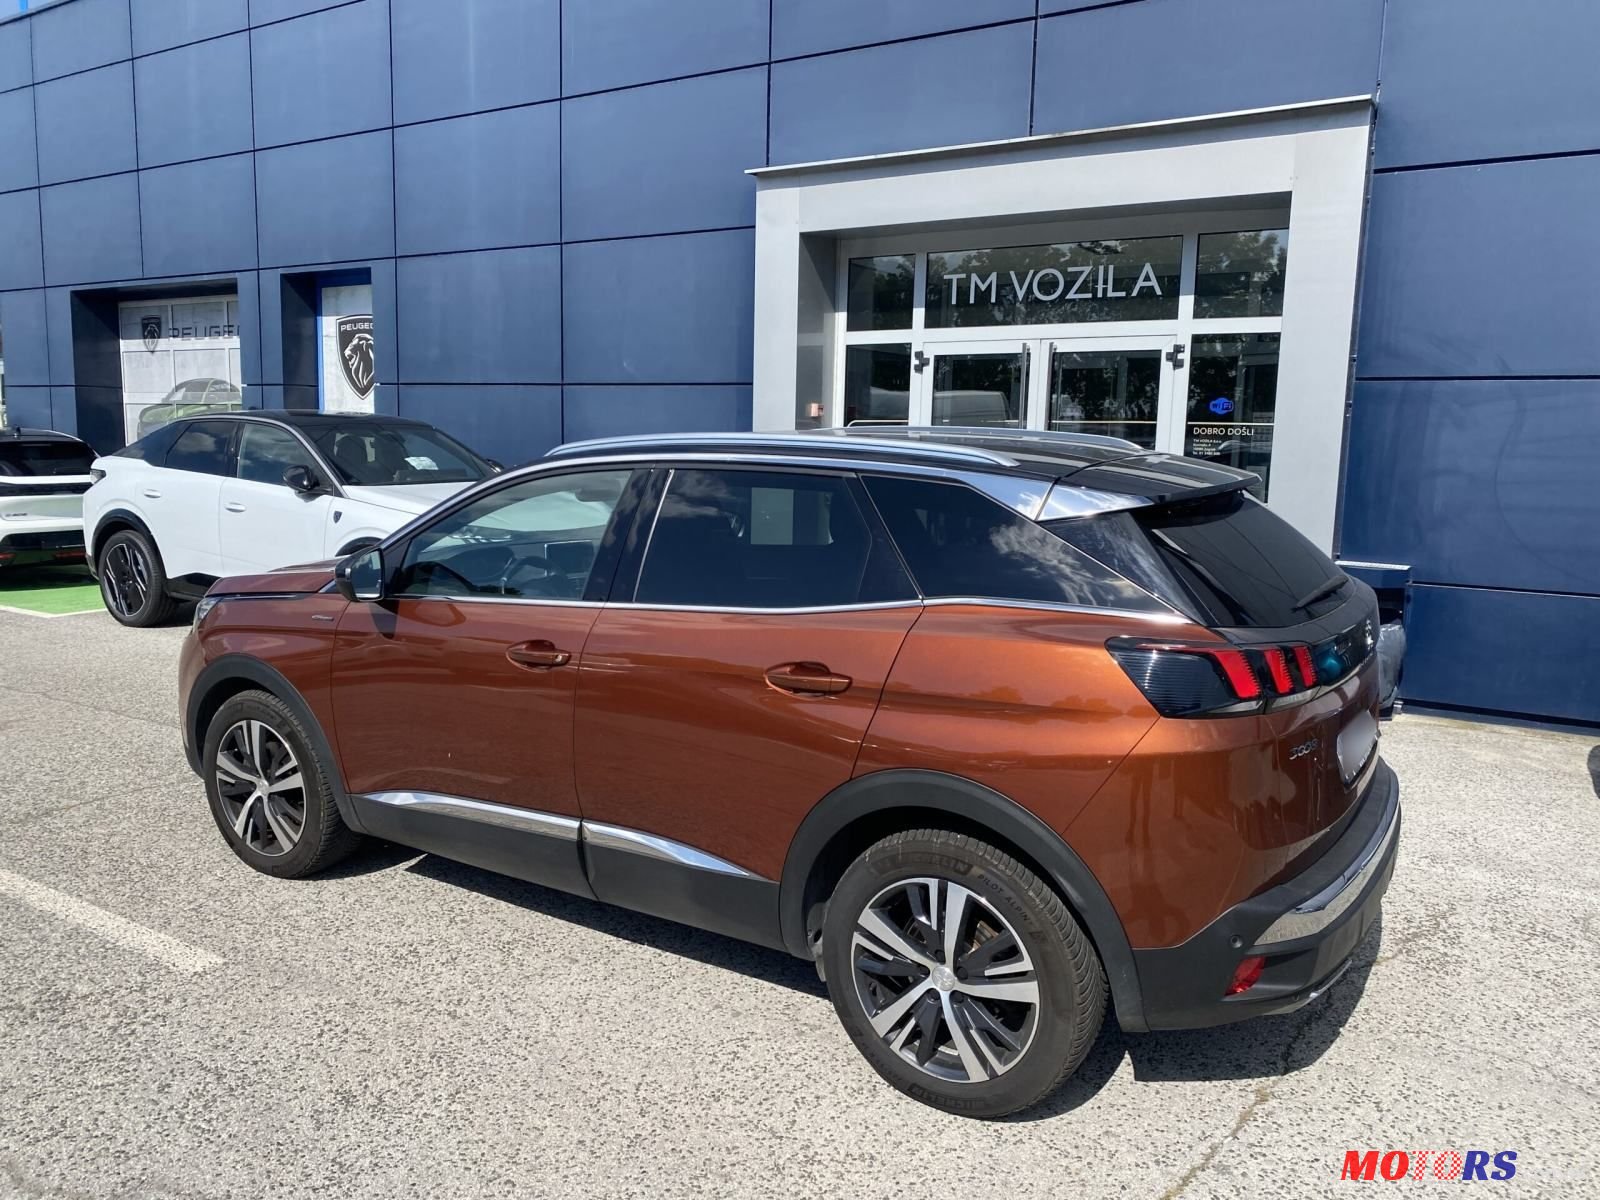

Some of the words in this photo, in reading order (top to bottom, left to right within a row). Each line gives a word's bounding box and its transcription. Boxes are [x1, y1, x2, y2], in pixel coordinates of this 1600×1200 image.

[943, 271, 998, 305] TM
[1009, 262, 1163, 301] VOZILA
[1193, 427, 1226, 435] DOBRO
[1227, 426, 1254, 436] DOŠLI
